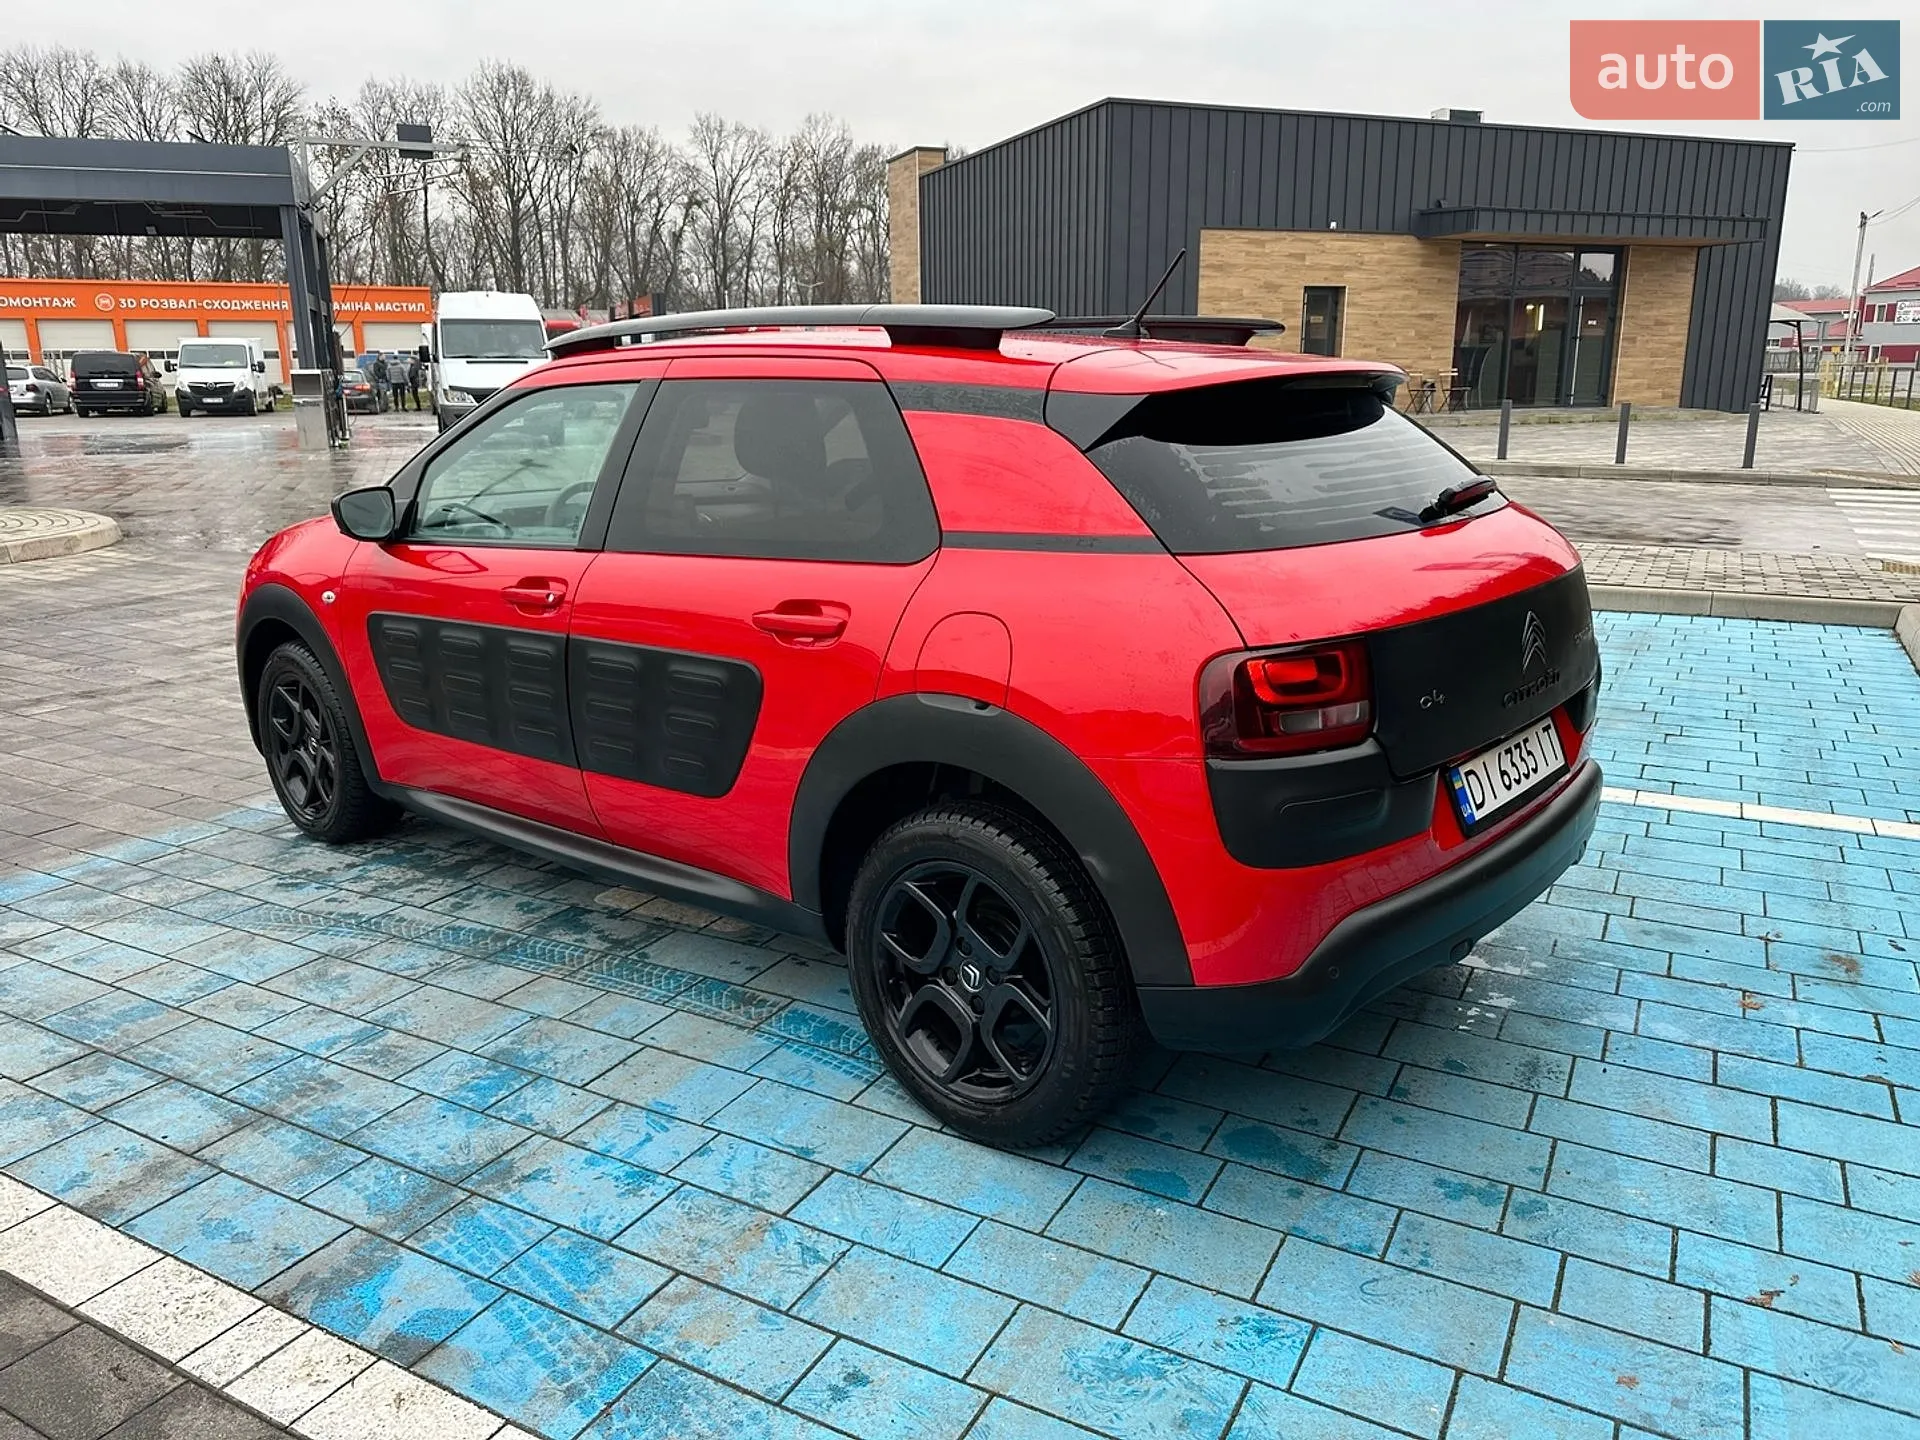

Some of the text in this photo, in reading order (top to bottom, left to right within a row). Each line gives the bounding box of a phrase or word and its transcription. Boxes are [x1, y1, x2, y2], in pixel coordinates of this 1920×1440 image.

[119, 298, 289, 311] 3D РОЗВАЛ-СХОДЖЕННЯ
[333, 301, 426, 312] АМІНА МАСТИЛ
[1464, 723, 1559, 812] DI 6335 IT
